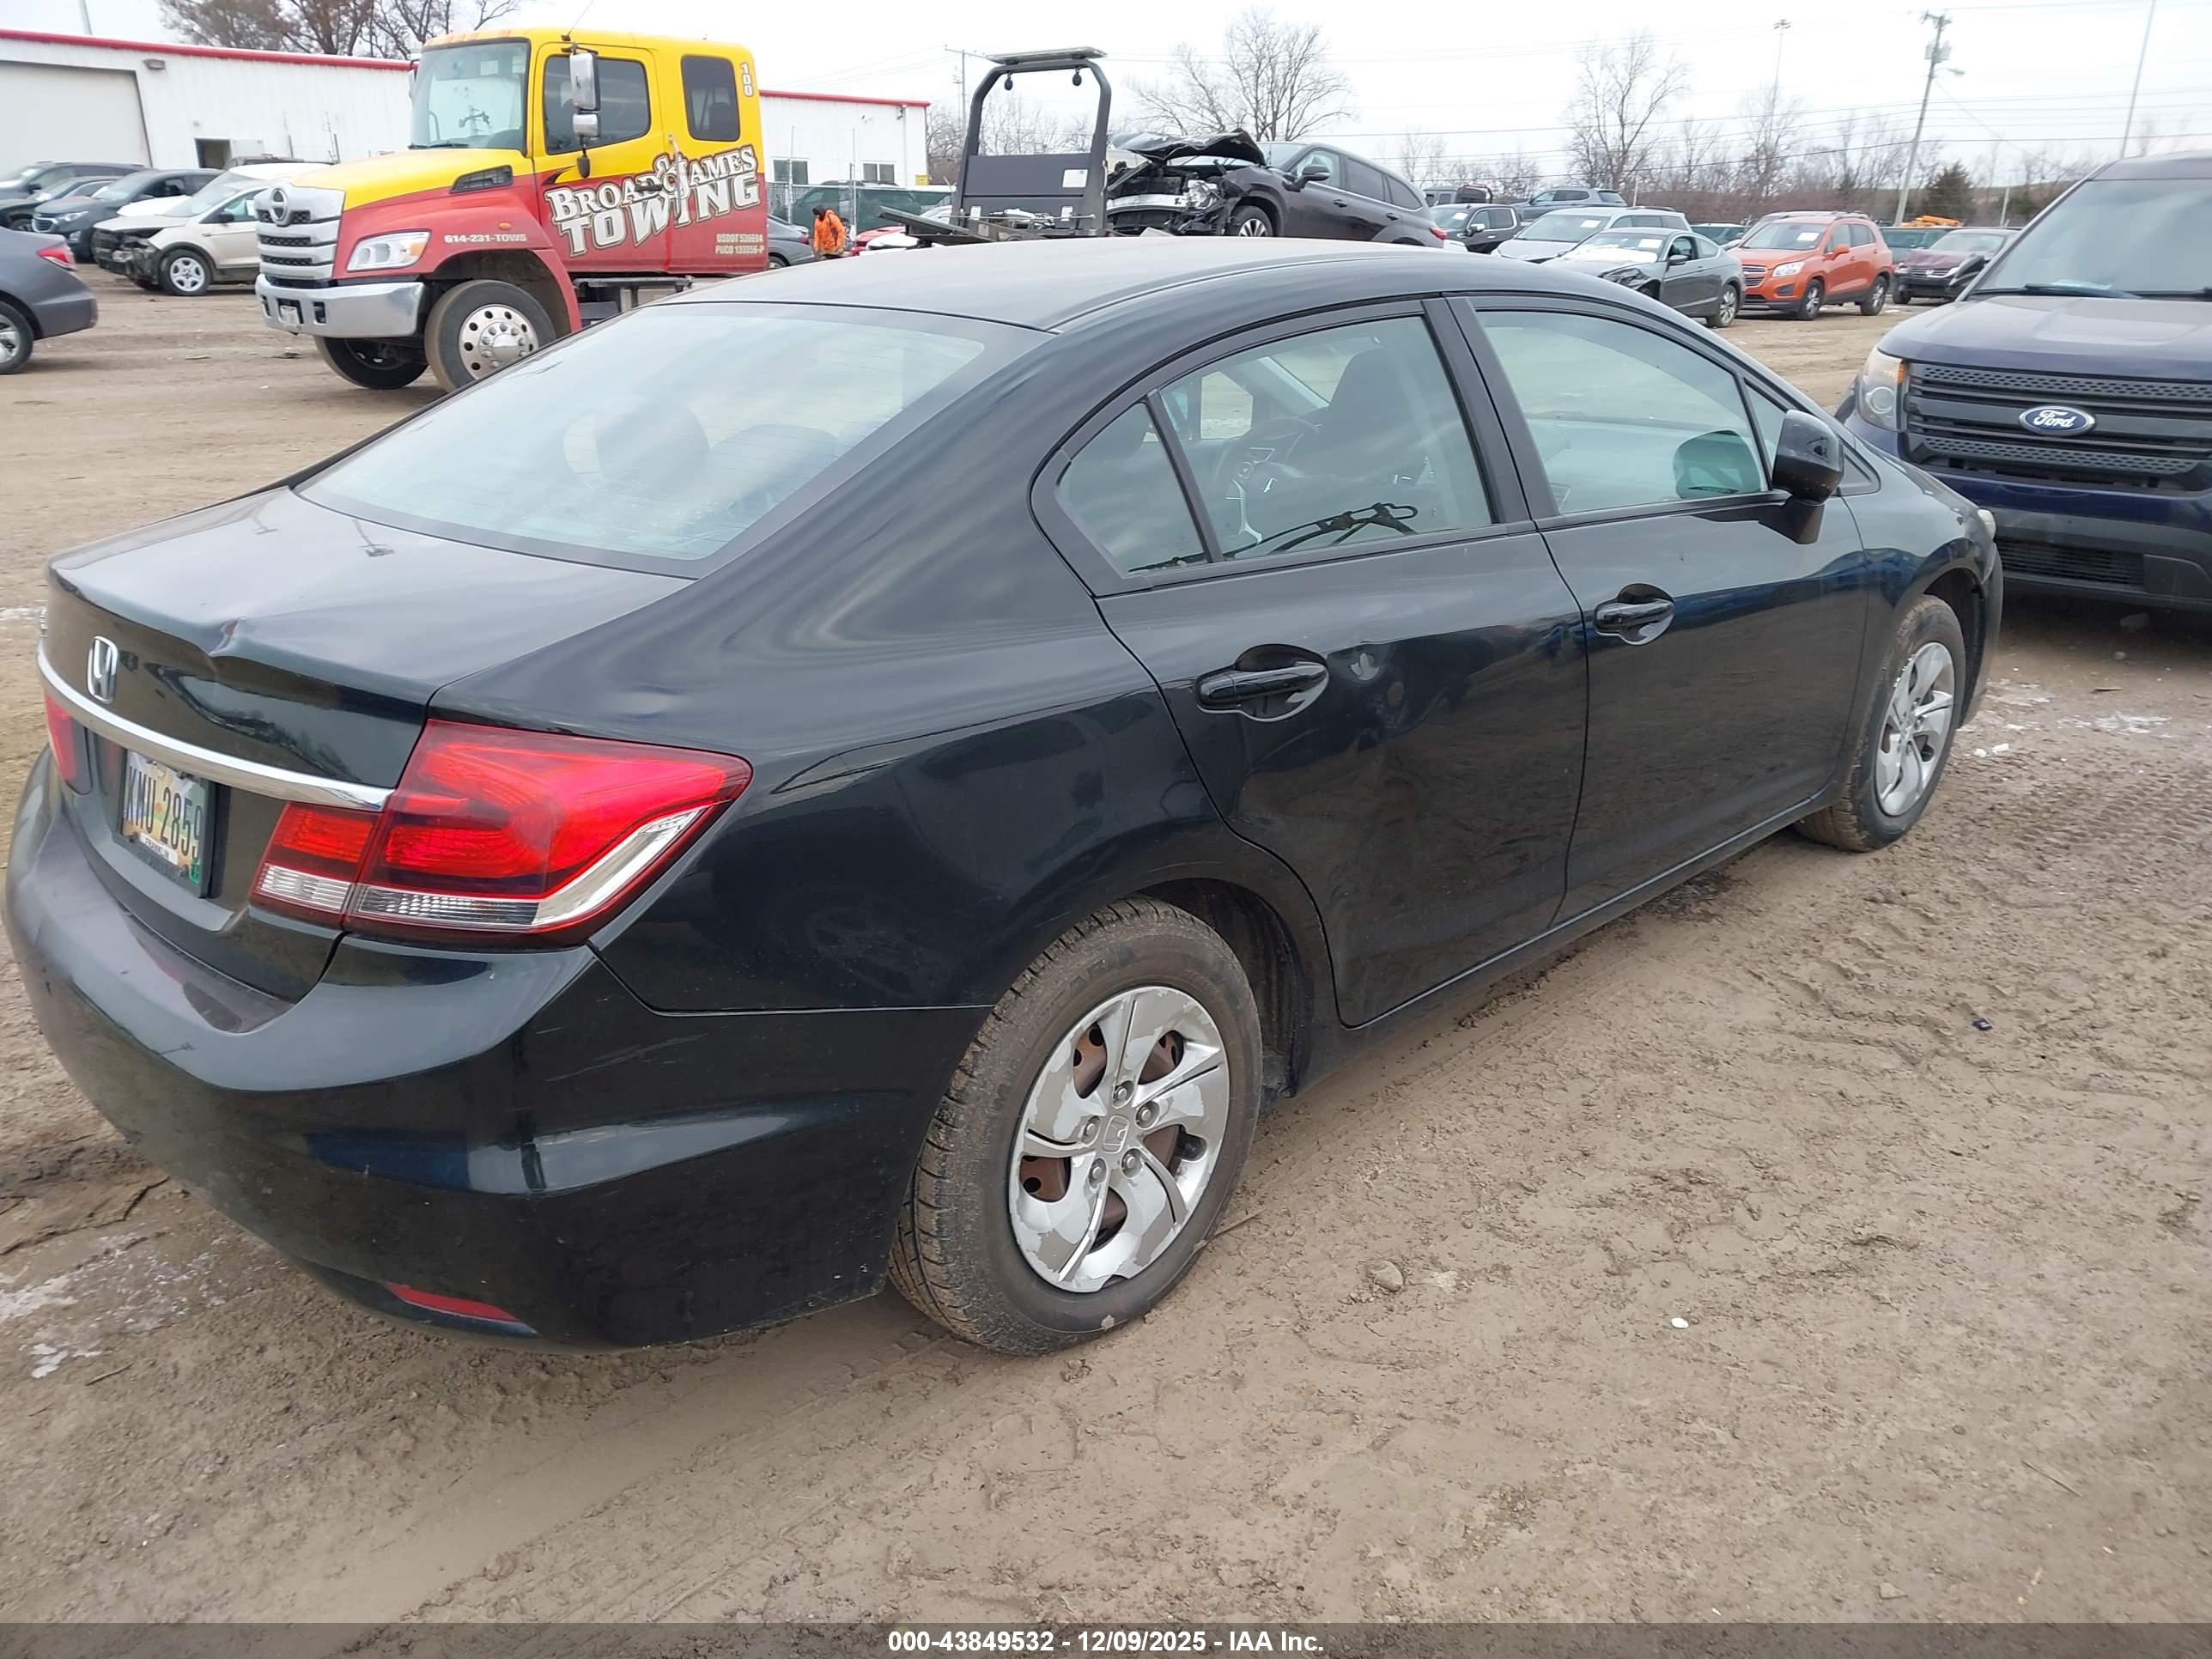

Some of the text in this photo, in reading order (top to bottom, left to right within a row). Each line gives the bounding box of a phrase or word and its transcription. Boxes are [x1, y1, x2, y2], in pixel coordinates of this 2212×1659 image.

[740, 62, 754, 97] 100
[544, 173, 664, 222] BROAD
[560, 173, 762, 256] TOWING
[444, 234, 527, 243] 614-231-TOWS
[2033, 410, 2077, 428] Ford
